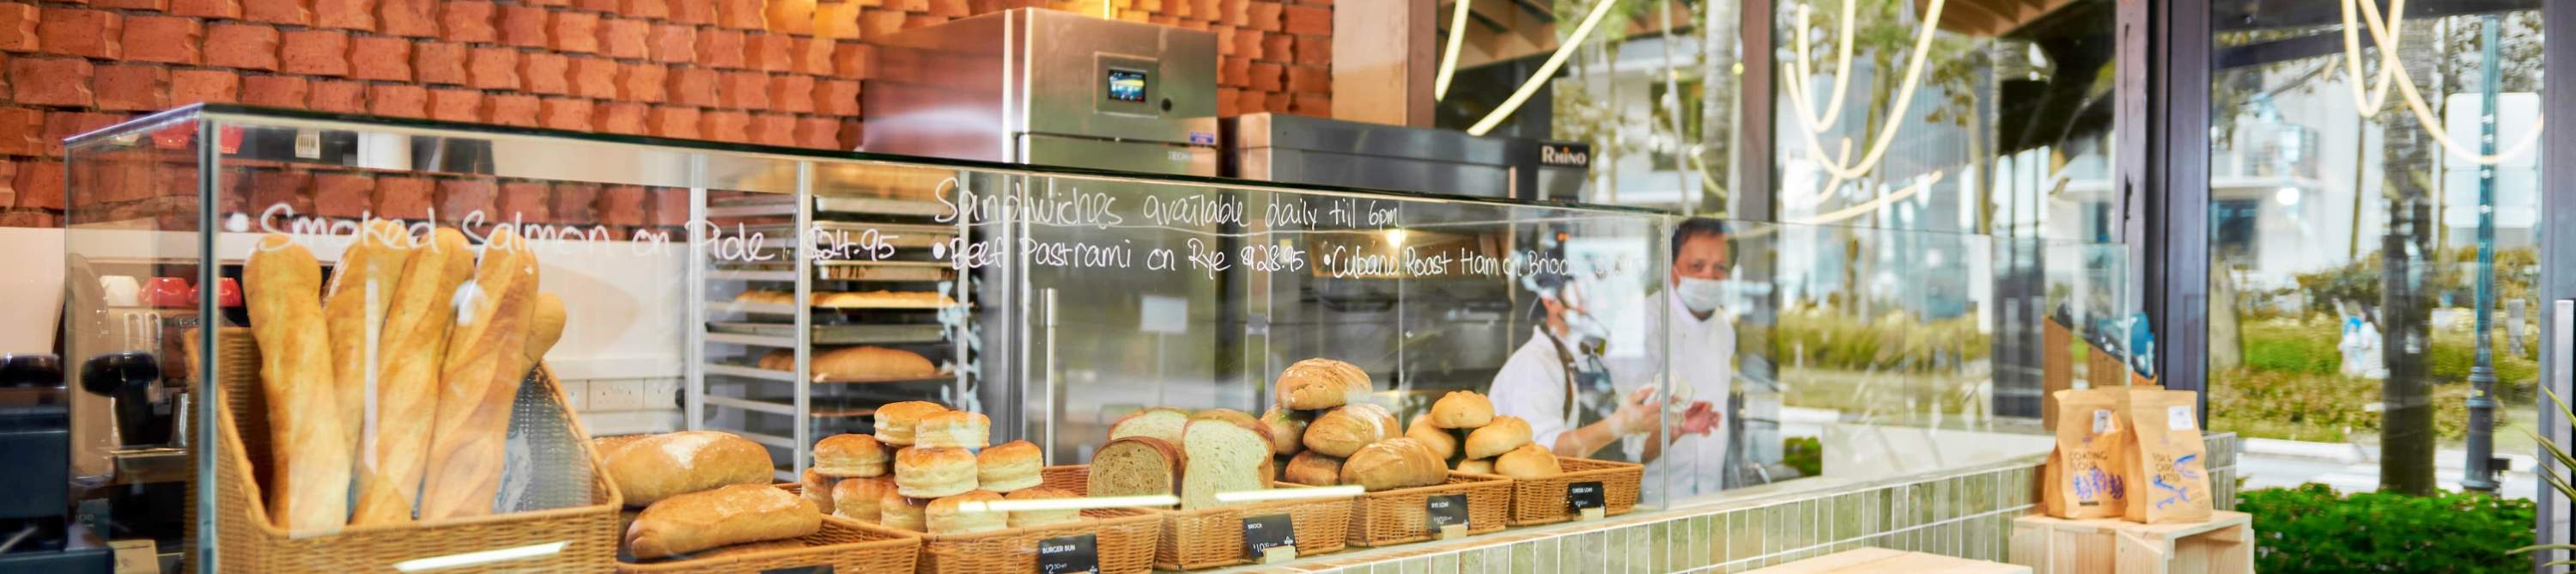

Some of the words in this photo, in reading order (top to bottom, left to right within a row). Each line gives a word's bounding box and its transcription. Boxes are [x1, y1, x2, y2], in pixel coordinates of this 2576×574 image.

[934, 177, 1123, 229] Sandwiches
[1143, 194, 1251, 228] available
[1265, 192, 1318, 230] daily
[1328, 198, 1357, 229] till
[1369, 199, 1399, 230] 6pm
[259, 202, 440, 254] Smoked
[462, 209, 614, 258] Salmon
[631, 228, 671, 257] on
[684, 219, 775, 262] Pide
[803, 226, 899, 261] $24.95
[950, 236, 1004, 270] Beef
[1018, 238, 1131, 268] Pastrami
[1147, 247, 1176, 272] on
[1188, 237, 1231, 280] Rye
[1331, 245, 1400, 279] Cubano
[1404, 246, 1453, 277] Roast
[1460, 247, 1499, 276] Ham
[1503, 254, 1522, 278] on
[1042, 545, 1064, 554] BURGER
[1064, 544, 1076, 553] BUN
